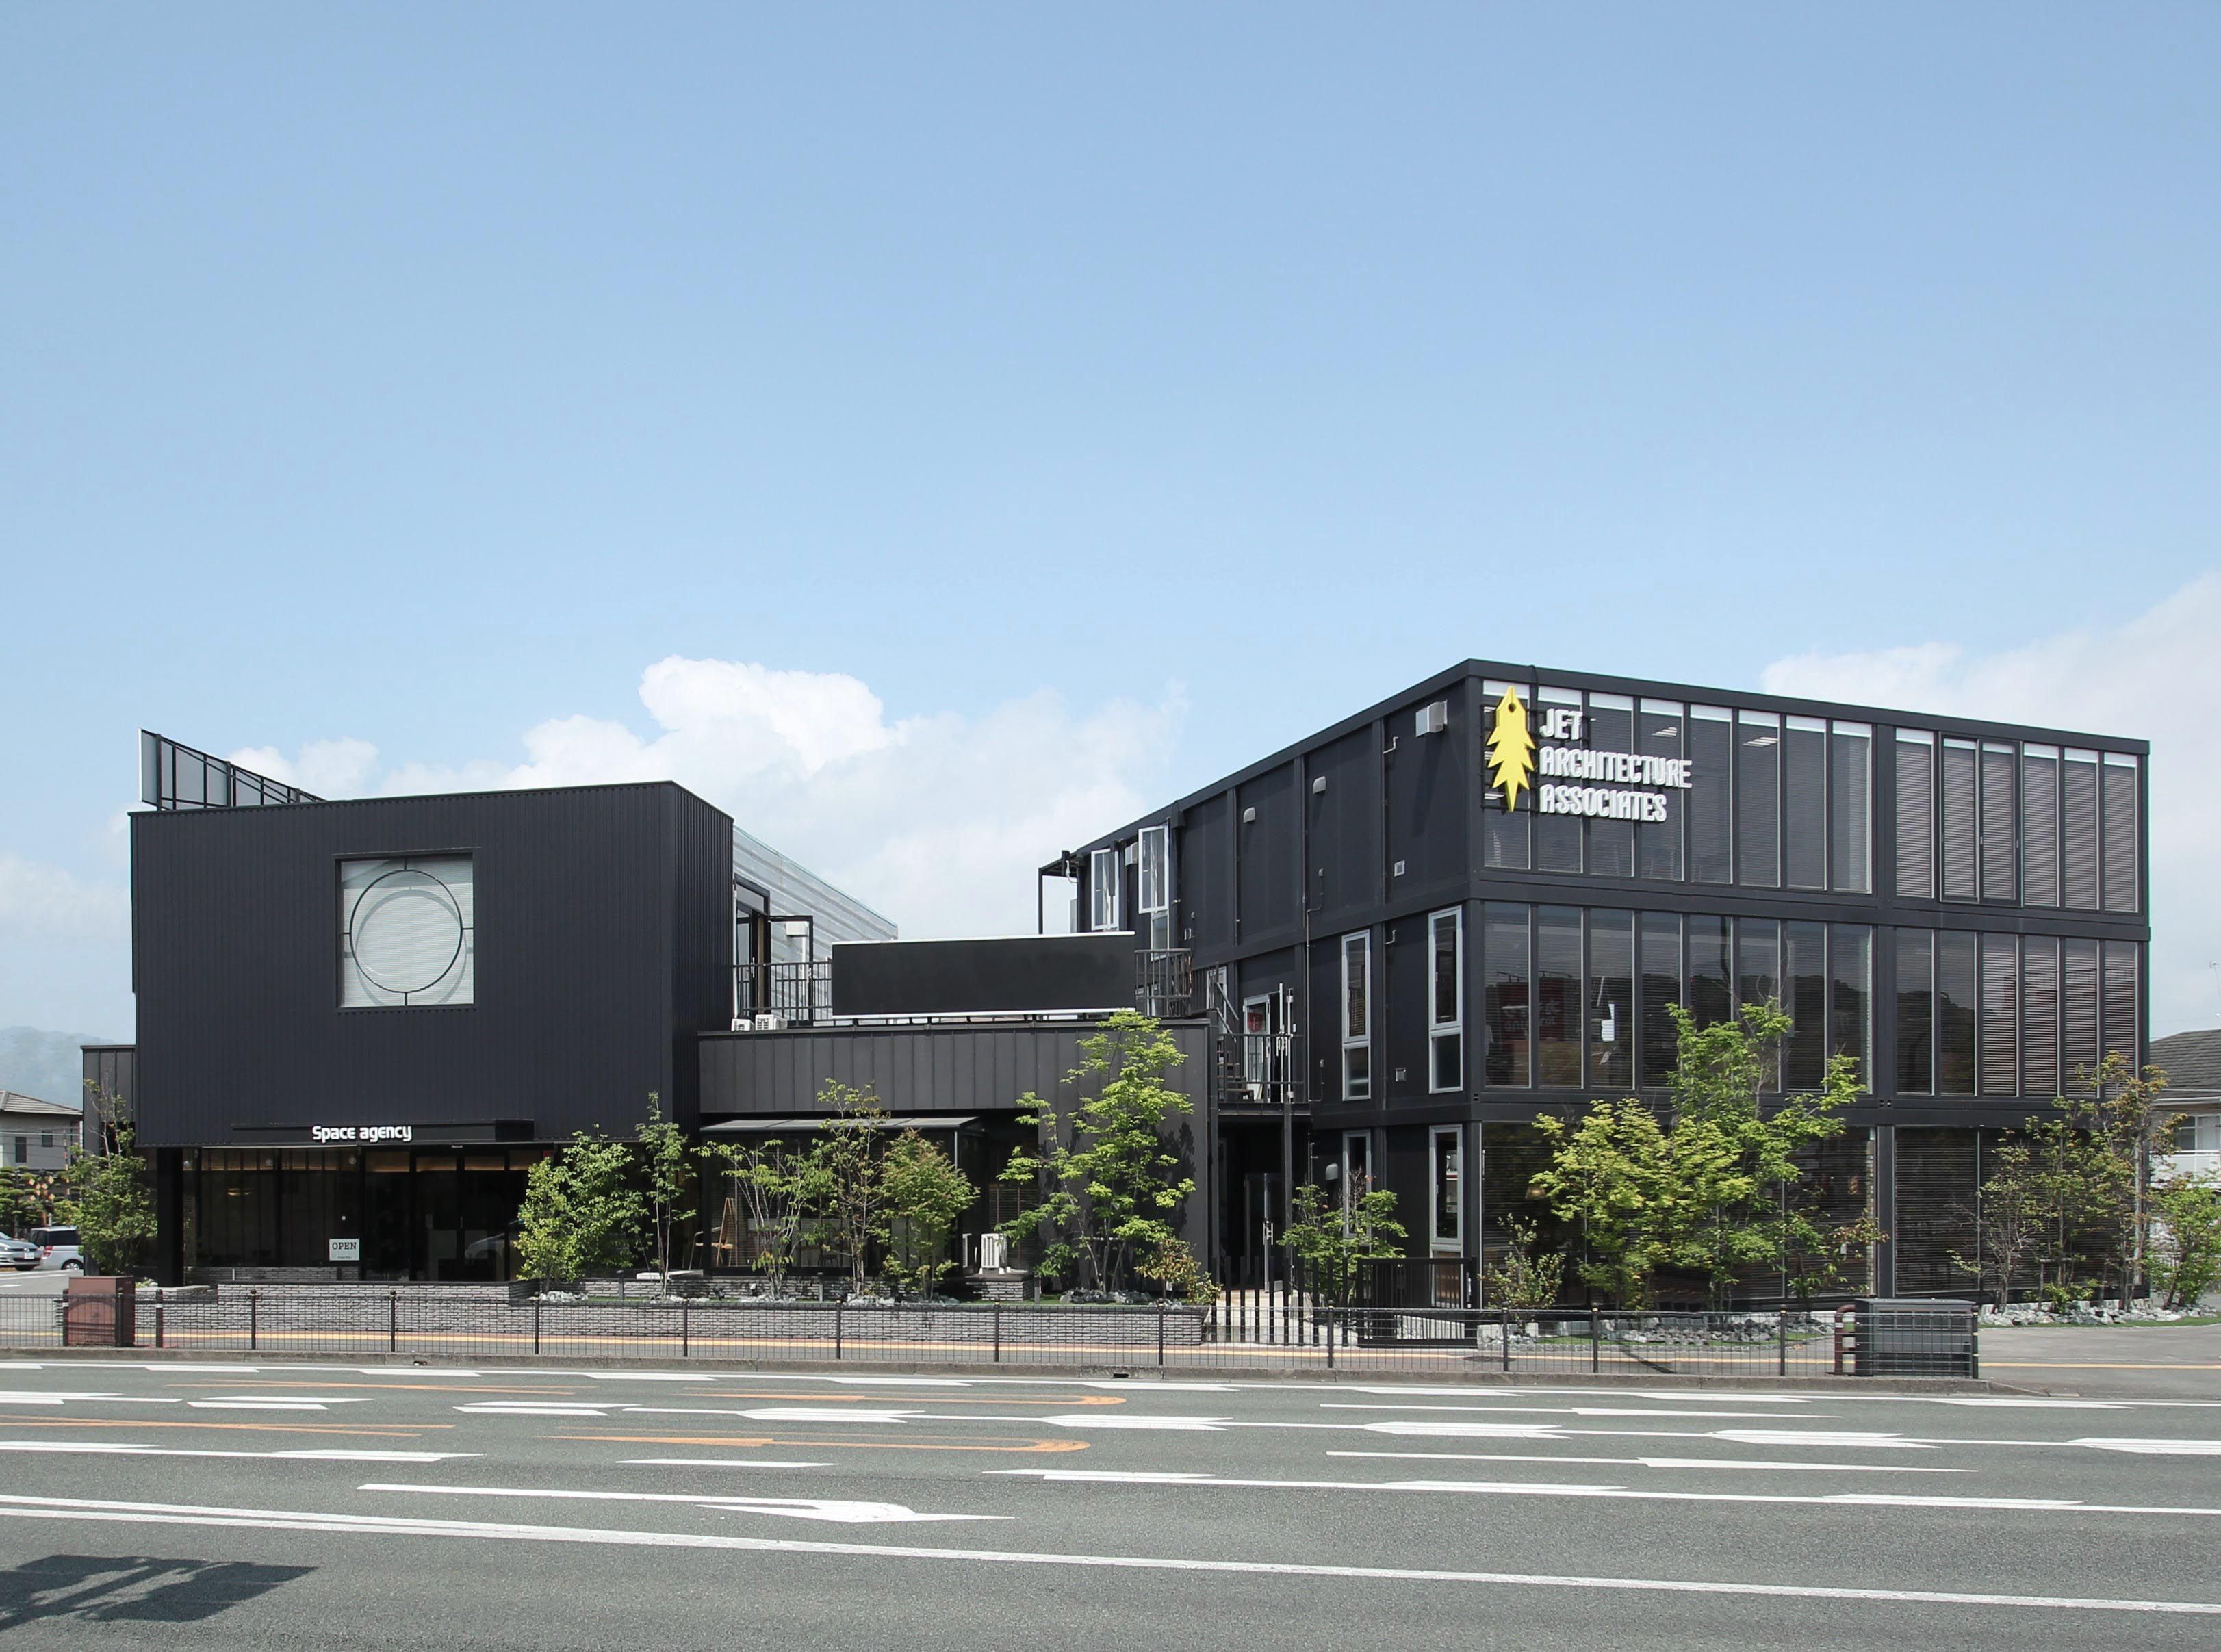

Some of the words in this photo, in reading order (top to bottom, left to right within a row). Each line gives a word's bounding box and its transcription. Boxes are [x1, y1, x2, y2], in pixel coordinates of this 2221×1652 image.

[1539, 708, 1583, 740] JET
[1539, 746, 1693, 788] ARCHITECTURE
[1539, 784, 1667, 822] ASSOCIATES
[312, 1126, 356, 1143] Space
[359, 1126, 411, 1143] agency
